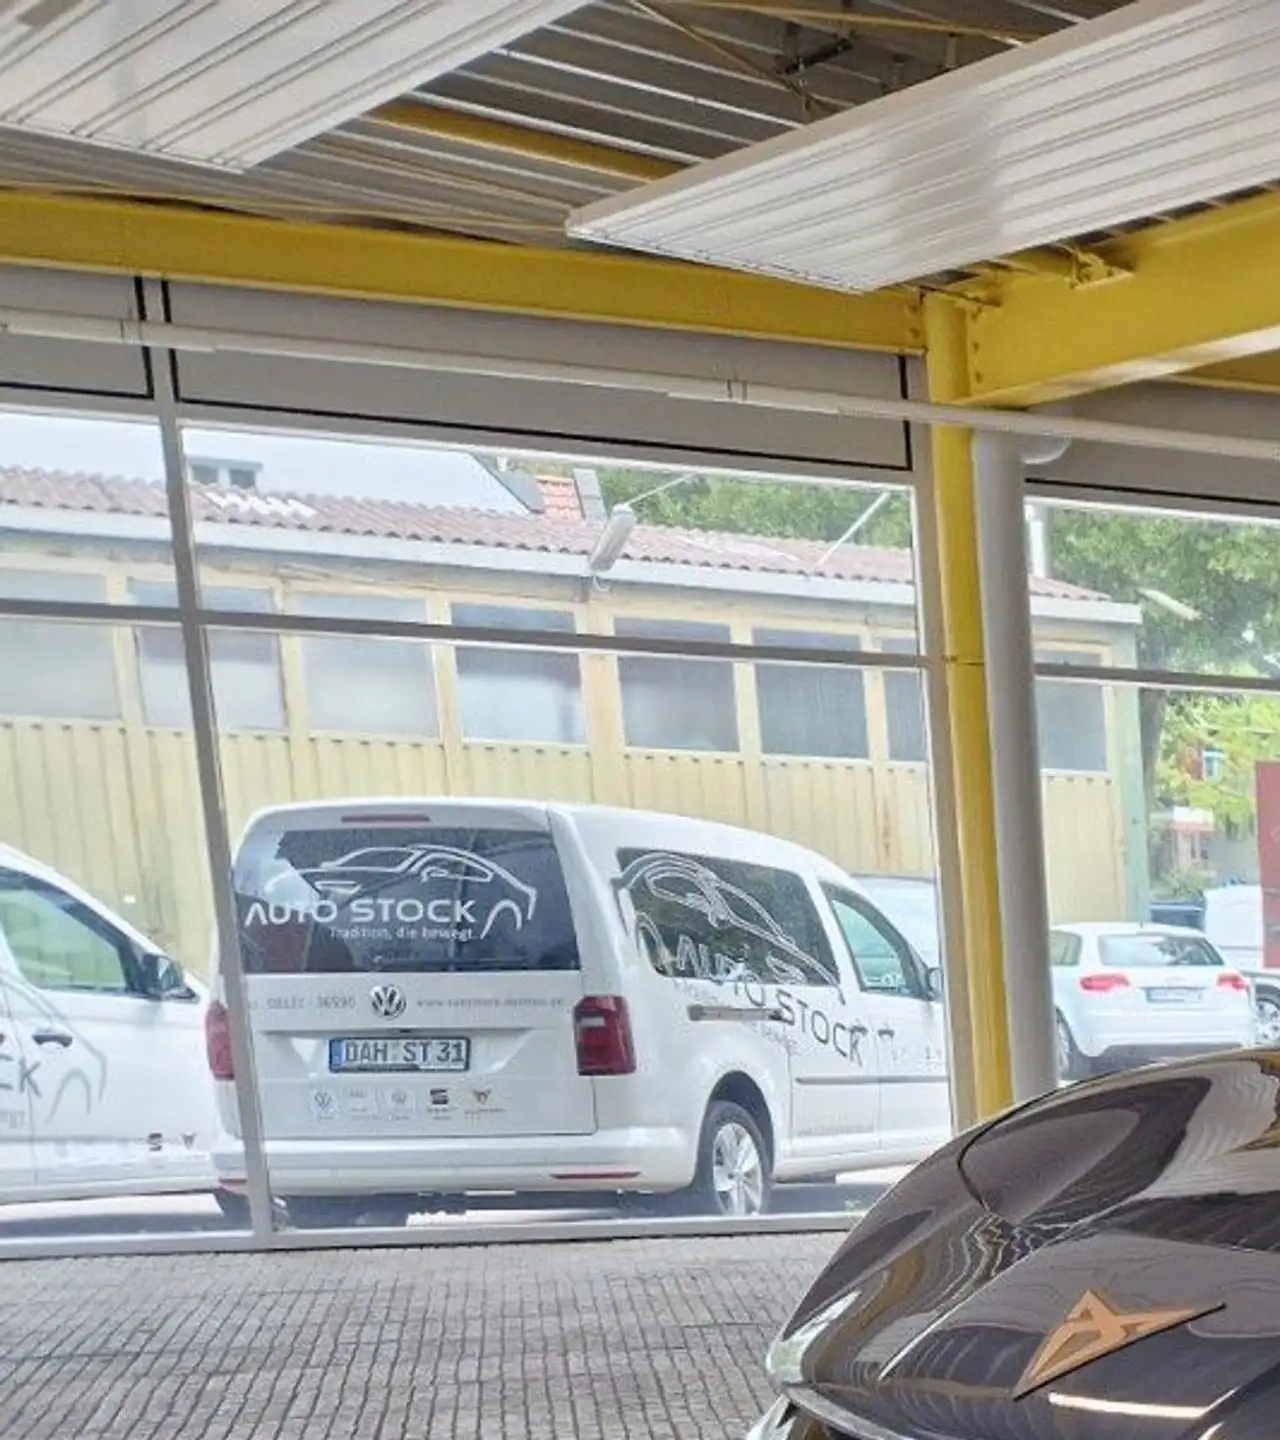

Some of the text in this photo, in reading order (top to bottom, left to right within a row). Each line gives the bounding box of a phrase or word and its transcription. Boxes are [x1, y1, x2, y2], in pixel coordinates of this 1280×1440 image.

[244, 898, 477, 926] AUTO STOCK
[345, 1041, 465, 1063] DAH ST 31
